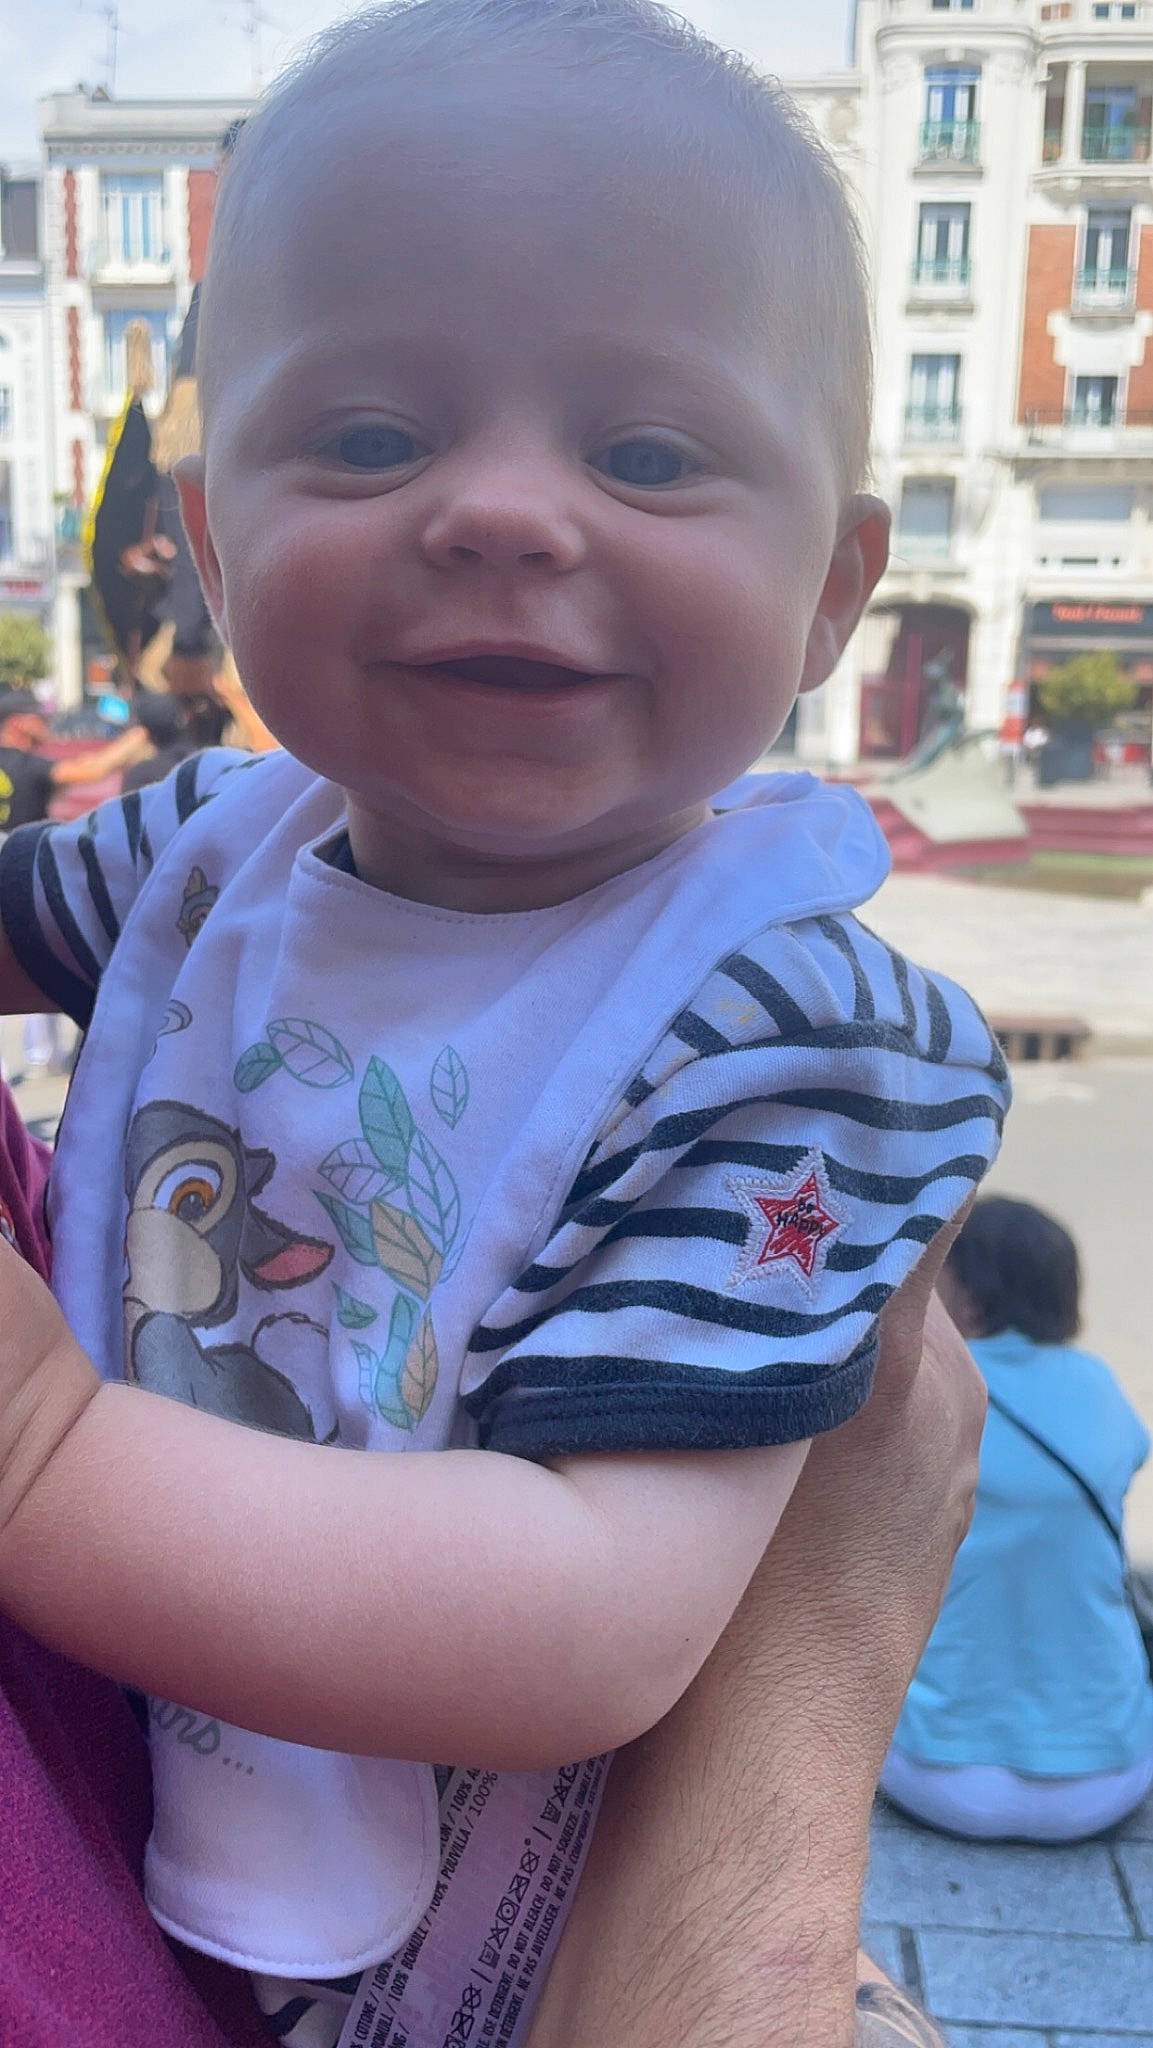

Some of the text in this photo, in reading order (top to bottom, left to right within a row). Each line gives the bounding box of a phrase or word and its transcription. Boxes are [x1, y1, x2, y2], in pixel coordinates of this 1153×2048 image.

[354, 2000, 376, 2039] COTONE
[449, 1780, 472, 1811] 100%
[387, 1970, 408, 2001] 100%
[401, 1926, 428, 1969] BOMULL
[440, 1828, 470, 1879] PUUVILLA
[468, 1770, 497, 1816] 100%
[560, 1865, 574, 1886] PAS
[506, 1953, 520, 1969] DO
[513, 1930, 528, 1953] NOT
[539, 1875, 553, 1891] DO
[546, 1853, 562, 1875] NOT
[515, 1975, 530, 1991] NE
[522, 1955, 537, 1977] PAS
